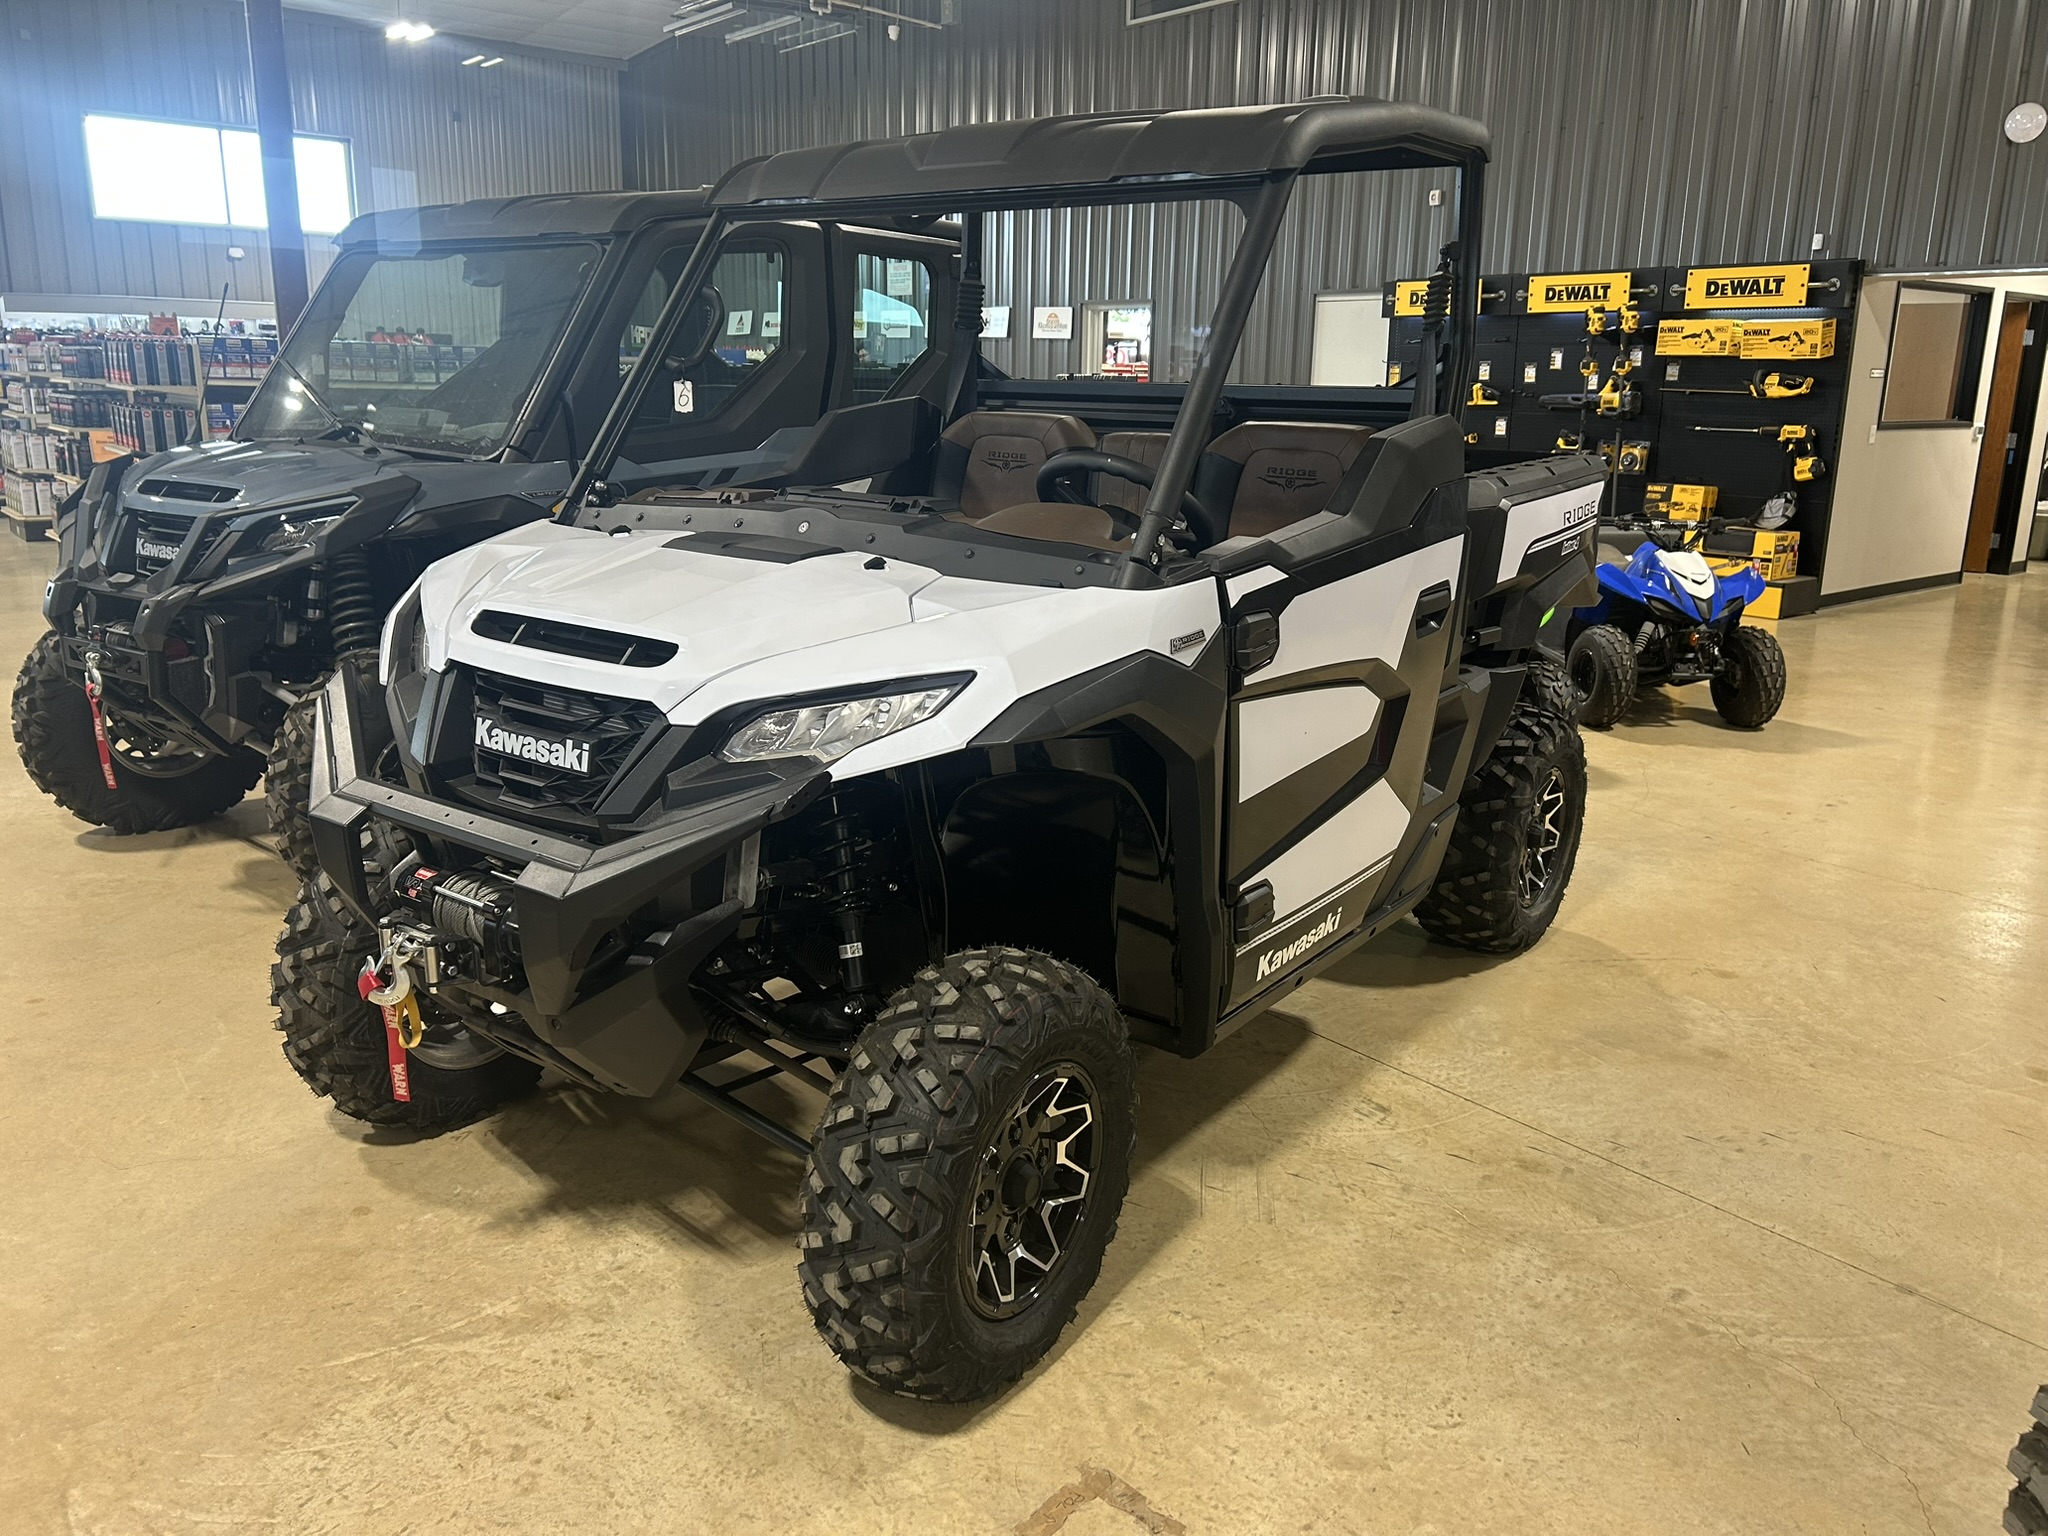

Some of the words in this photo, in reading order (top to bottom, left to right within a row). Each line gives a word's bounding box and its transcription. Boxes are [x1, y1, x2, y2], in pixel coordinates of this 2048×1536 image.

[988, 450, 1028, 461] RIDGE
[1266, 466, 1318, 478] RIDGE
[1563, 500, 1596, 526] RIDGE
[136, 537, 183, 560] Kawasa
[1182, 631, 1204, 644] RIDGE
[474, 716, 590, 773] Kawasaki
[1256, 906, 1343, 982] Kawasaki
[391, 1063, 408, 1096] WARN
